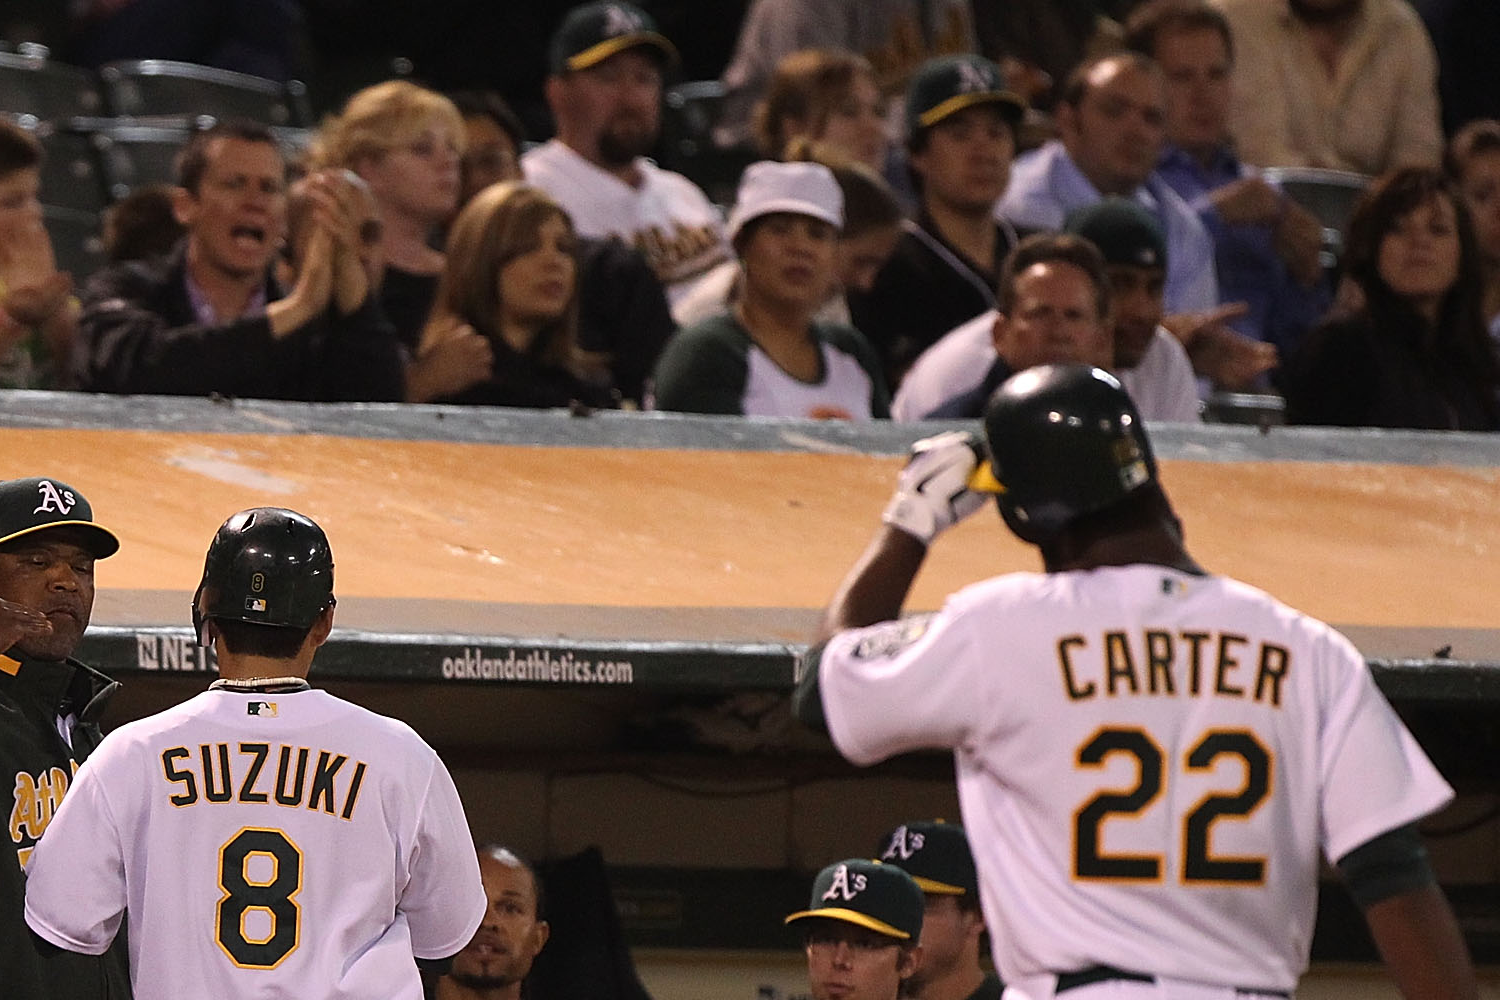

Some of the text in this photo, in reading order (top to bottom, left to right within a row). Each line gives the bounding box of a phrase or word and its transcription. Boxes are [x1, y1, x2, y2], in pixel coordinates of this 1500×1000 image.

[33, 480, 76, 515] A's
[251, 572, 265, 592] 8
[442, 647, 634, 684] oaklandathletics.com
[1056, 629, 1292, 707] CARTER
[160, 741, 368, 823] SUZUKI
[1072, 725, 1274, 886] 22
[882, 824, 926, 861] A's
[214, 825, 304, 970] 8
[821, 863, 869, 901] A's
